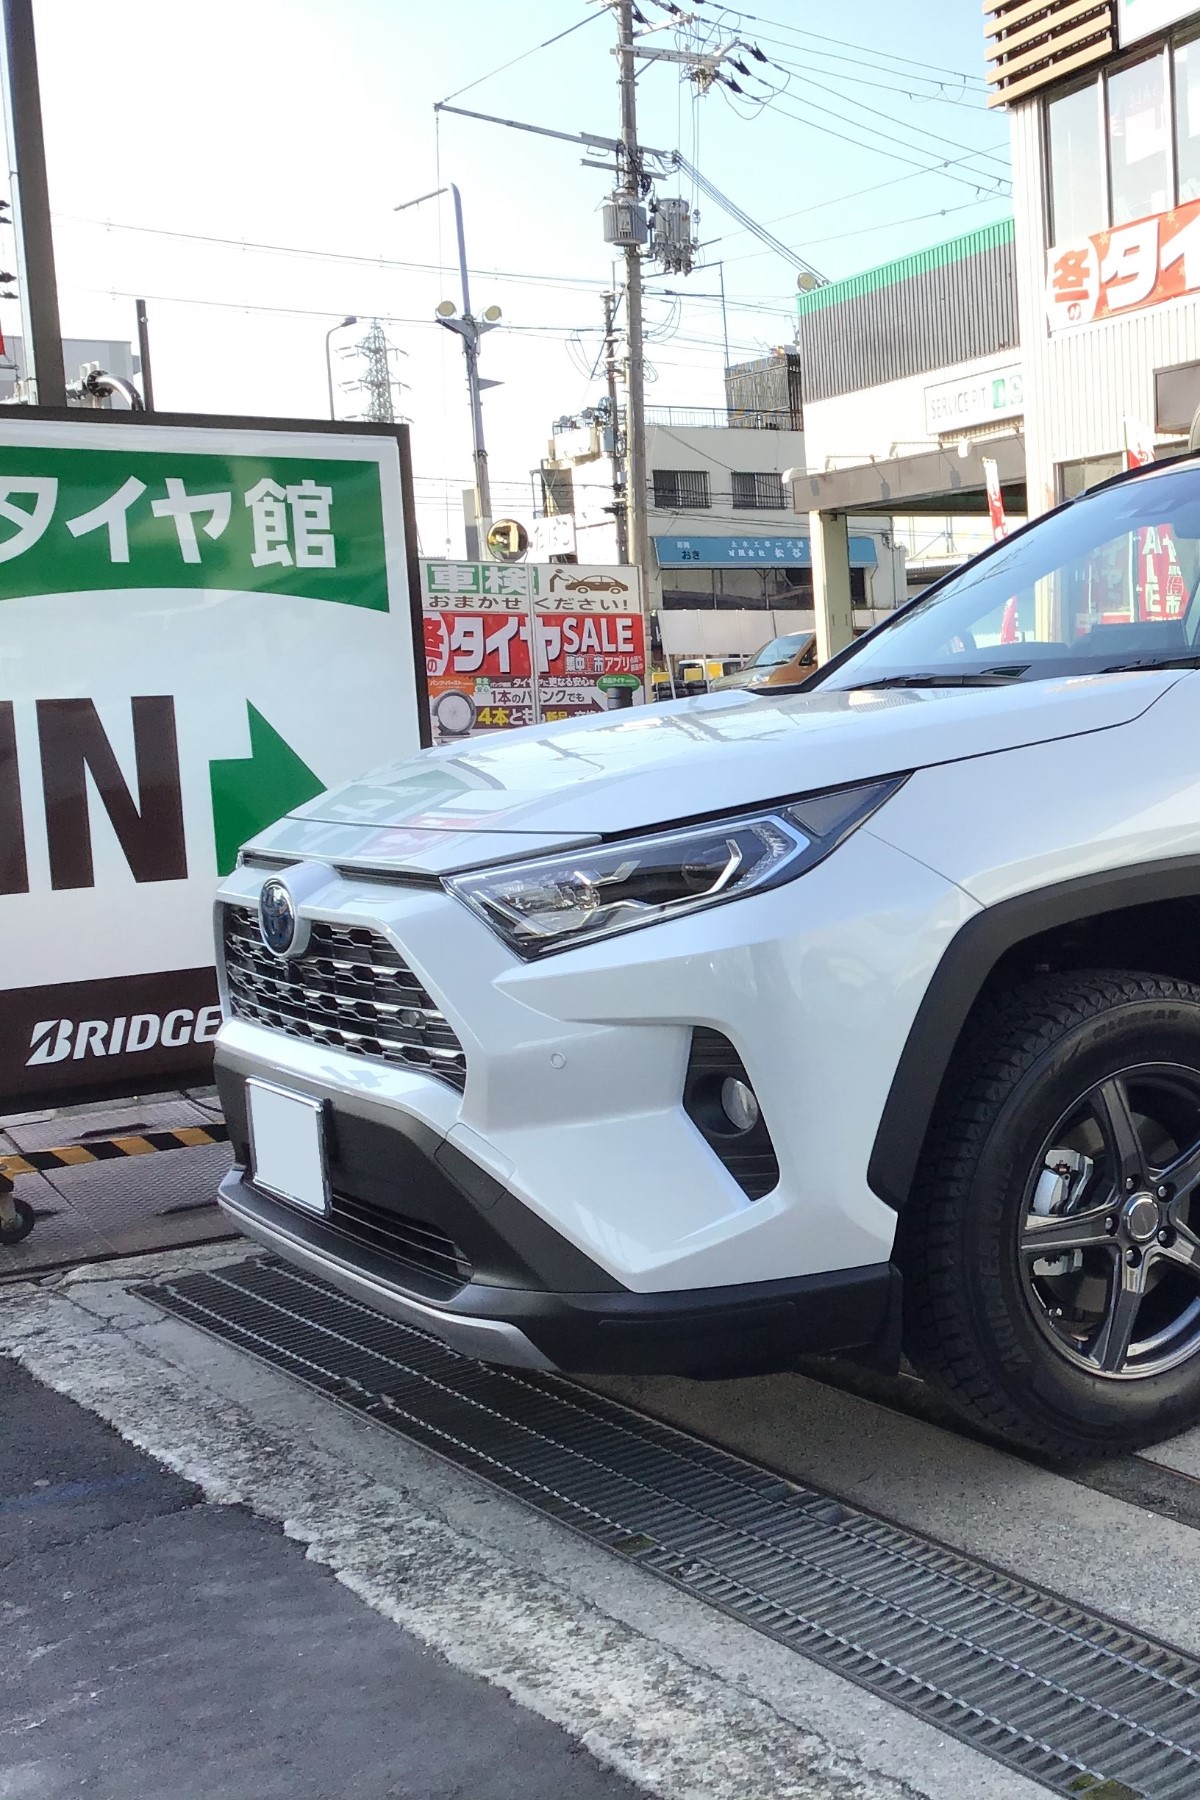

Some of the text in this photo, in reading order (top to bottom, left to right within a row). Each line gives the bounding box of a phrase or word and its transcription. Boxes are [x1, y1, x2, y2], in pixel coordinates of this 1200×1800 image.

[0, 475, 337, 569] タイヤ館
[430, 565, 536, 594] 車検
[604, 655, 629, 672] アプリ
[25, 1005, 222, 1066] BRIDGE
